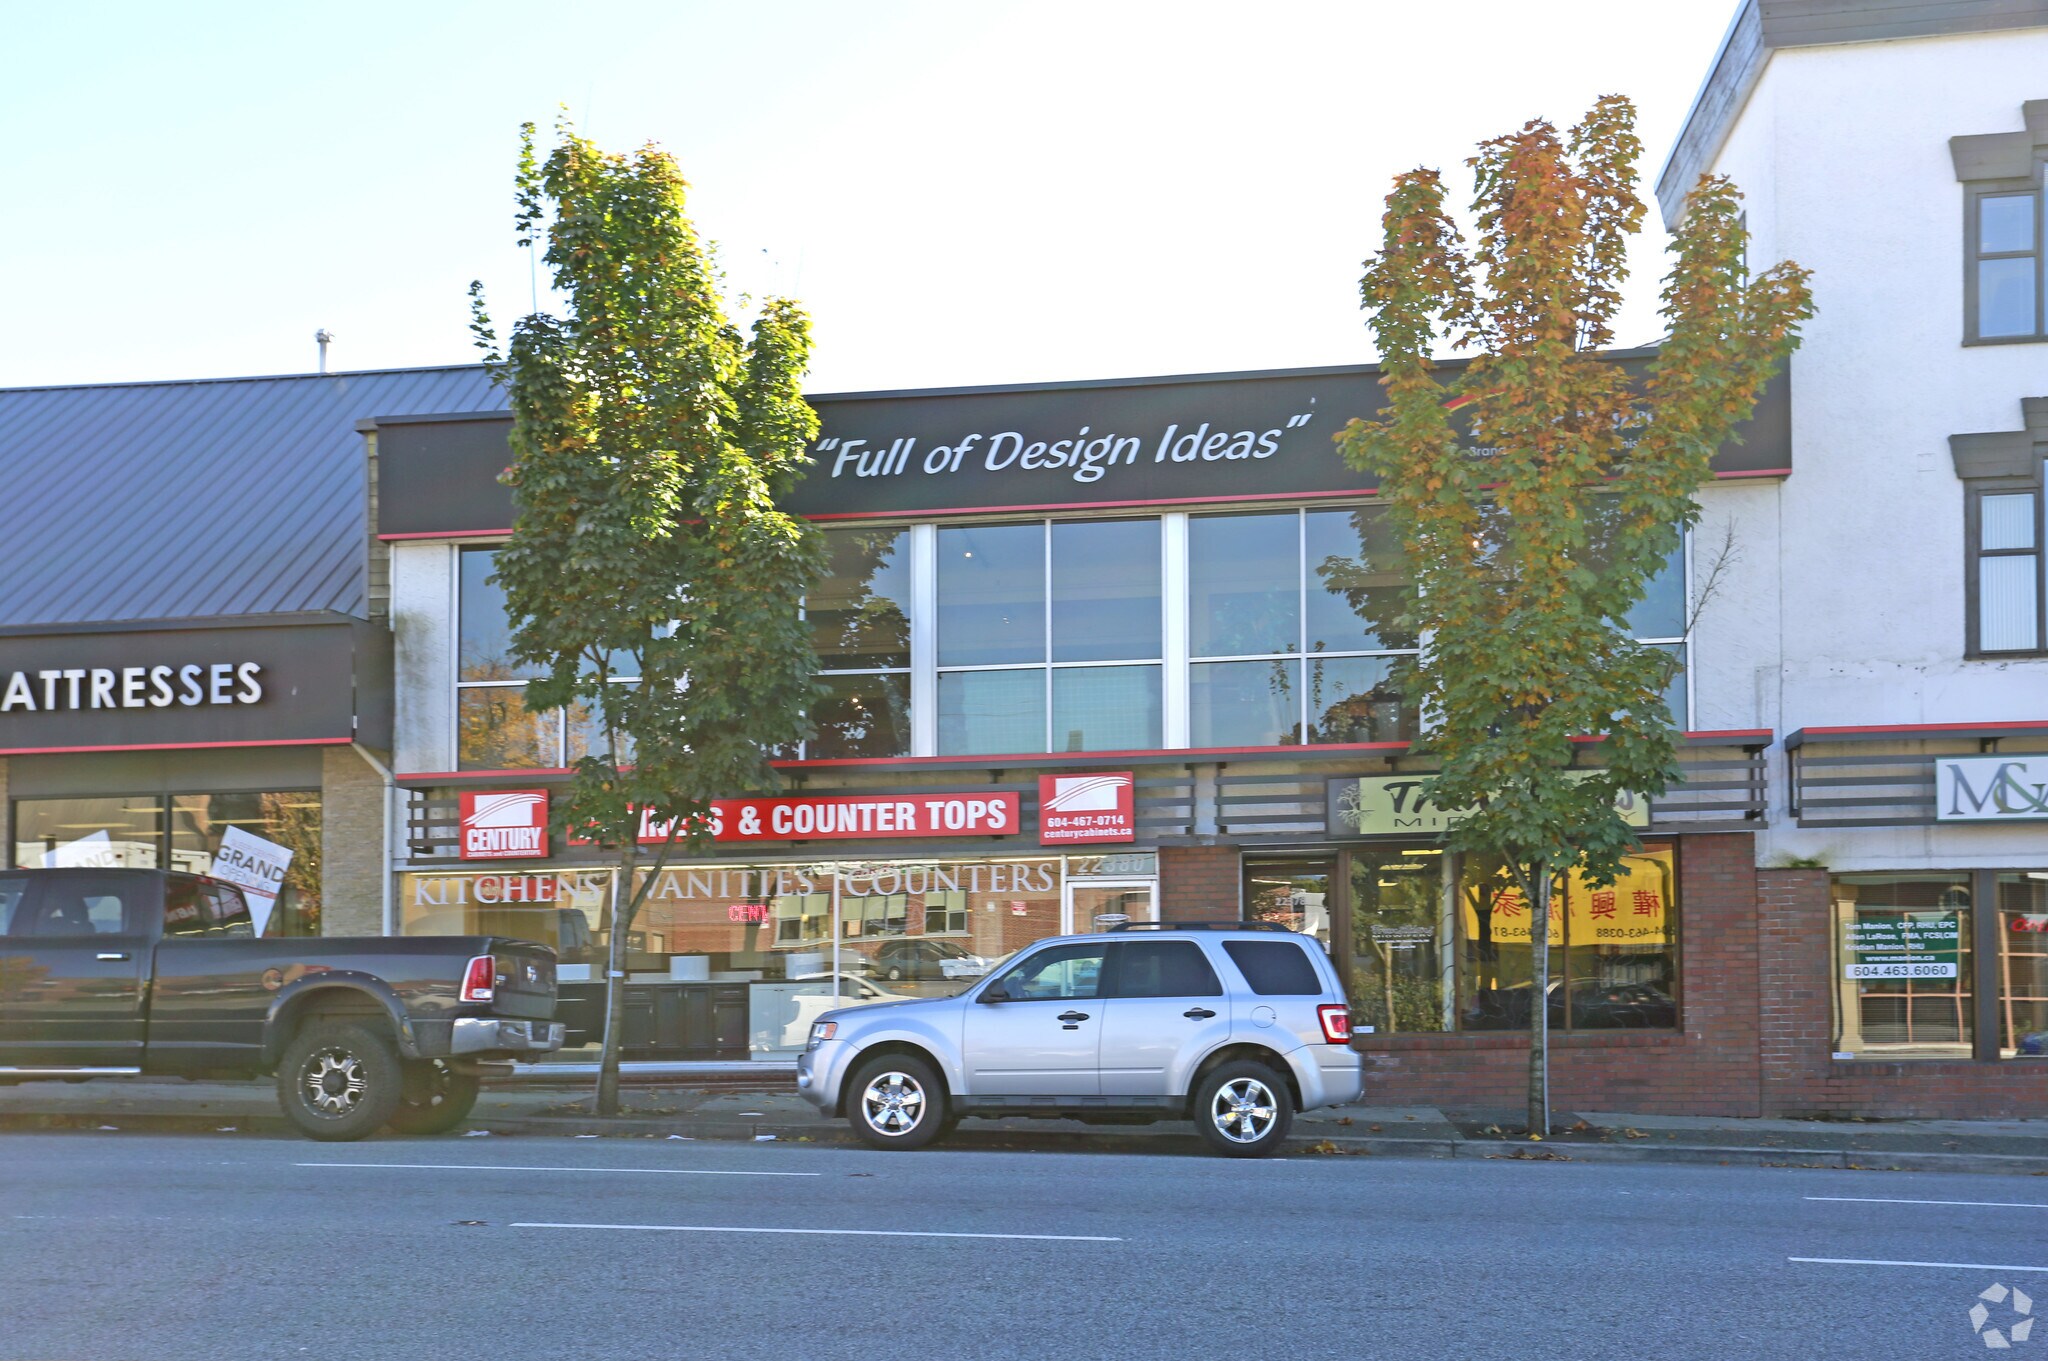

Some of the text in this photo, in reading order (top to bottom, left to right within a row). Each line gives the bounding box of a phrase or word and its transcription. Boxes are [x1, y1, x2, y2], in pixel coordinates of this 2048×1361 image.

[816, 413, 1312, 483] "Full of Design Ideas"
[0, 661, 262, 712] ATTRESSES
[738, 805, 762, 835] &
[772, 802, 916, 834] COUNTER
[925, 799, 1007, 830] TOPS
[1047, 814, 1125, 828] 604-467-0714
[466, 826, 542, 852] CENTURY
[1044, 827, 1132, 839] centurycabinets.ca
[217, 844, 286, 883] GRAND
[1077, 857, 1145, 873] 22380
[414, 872, 608, 906] KITCHENS
[845, 863, 1054, 897] COUNTERS
[1863, 922, 1894, 930] Manion,
[1938, 921, 1956, 929] EPC
[1865, 954, 1936, 962] www.manion.ca
[1853, 965, 1949, 977] 604.463.6060
